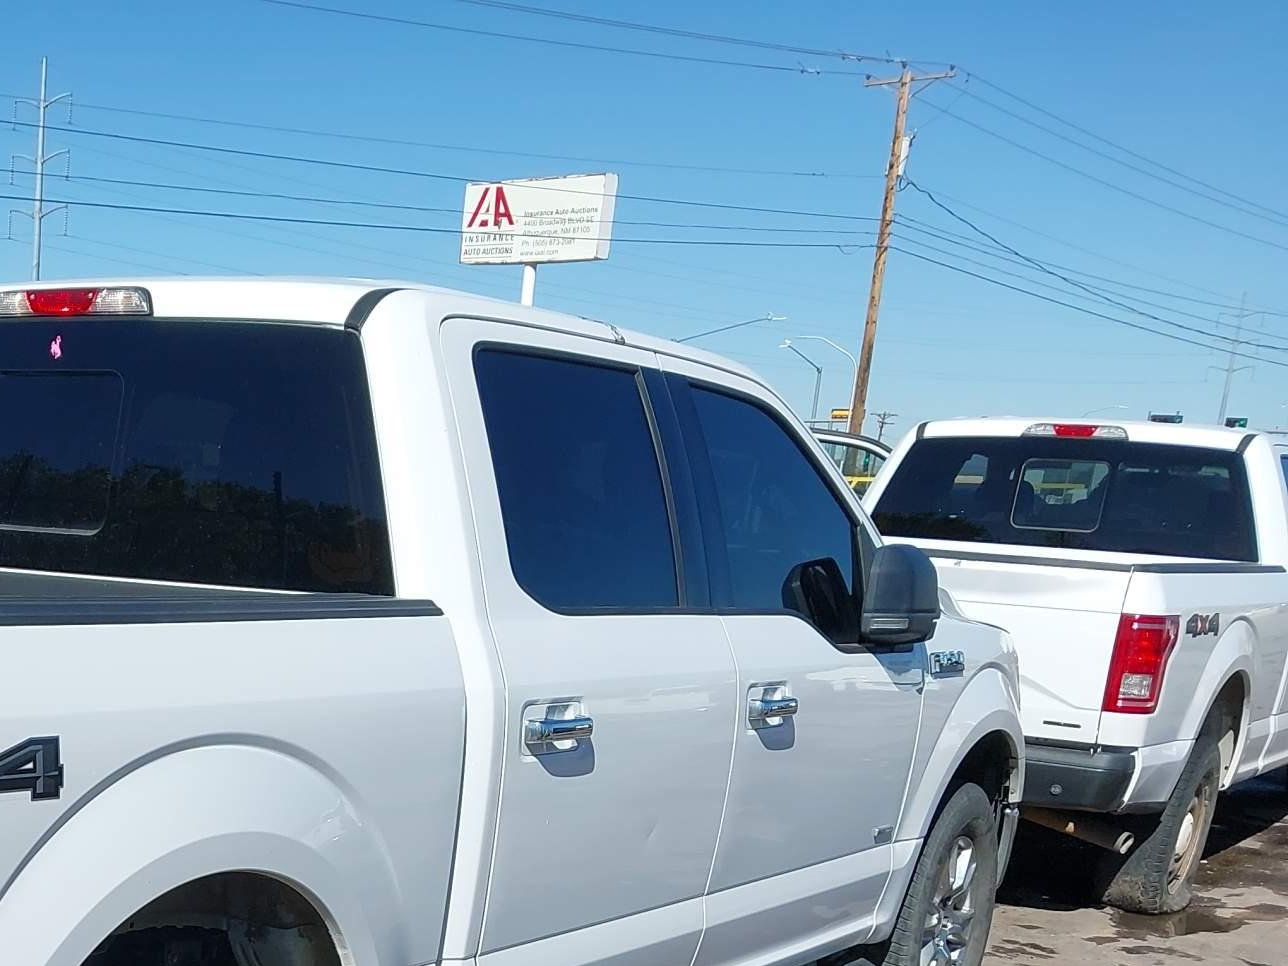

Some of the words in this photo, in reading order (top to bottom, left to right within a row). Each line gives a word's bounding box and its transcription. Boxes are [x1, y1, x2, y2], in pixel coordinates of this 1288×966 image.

[463, 232, 515, 243] INSURANCE
[463, 247, 481, 257] AUTO
[481, 246, 513, 256] AUCTIONS
